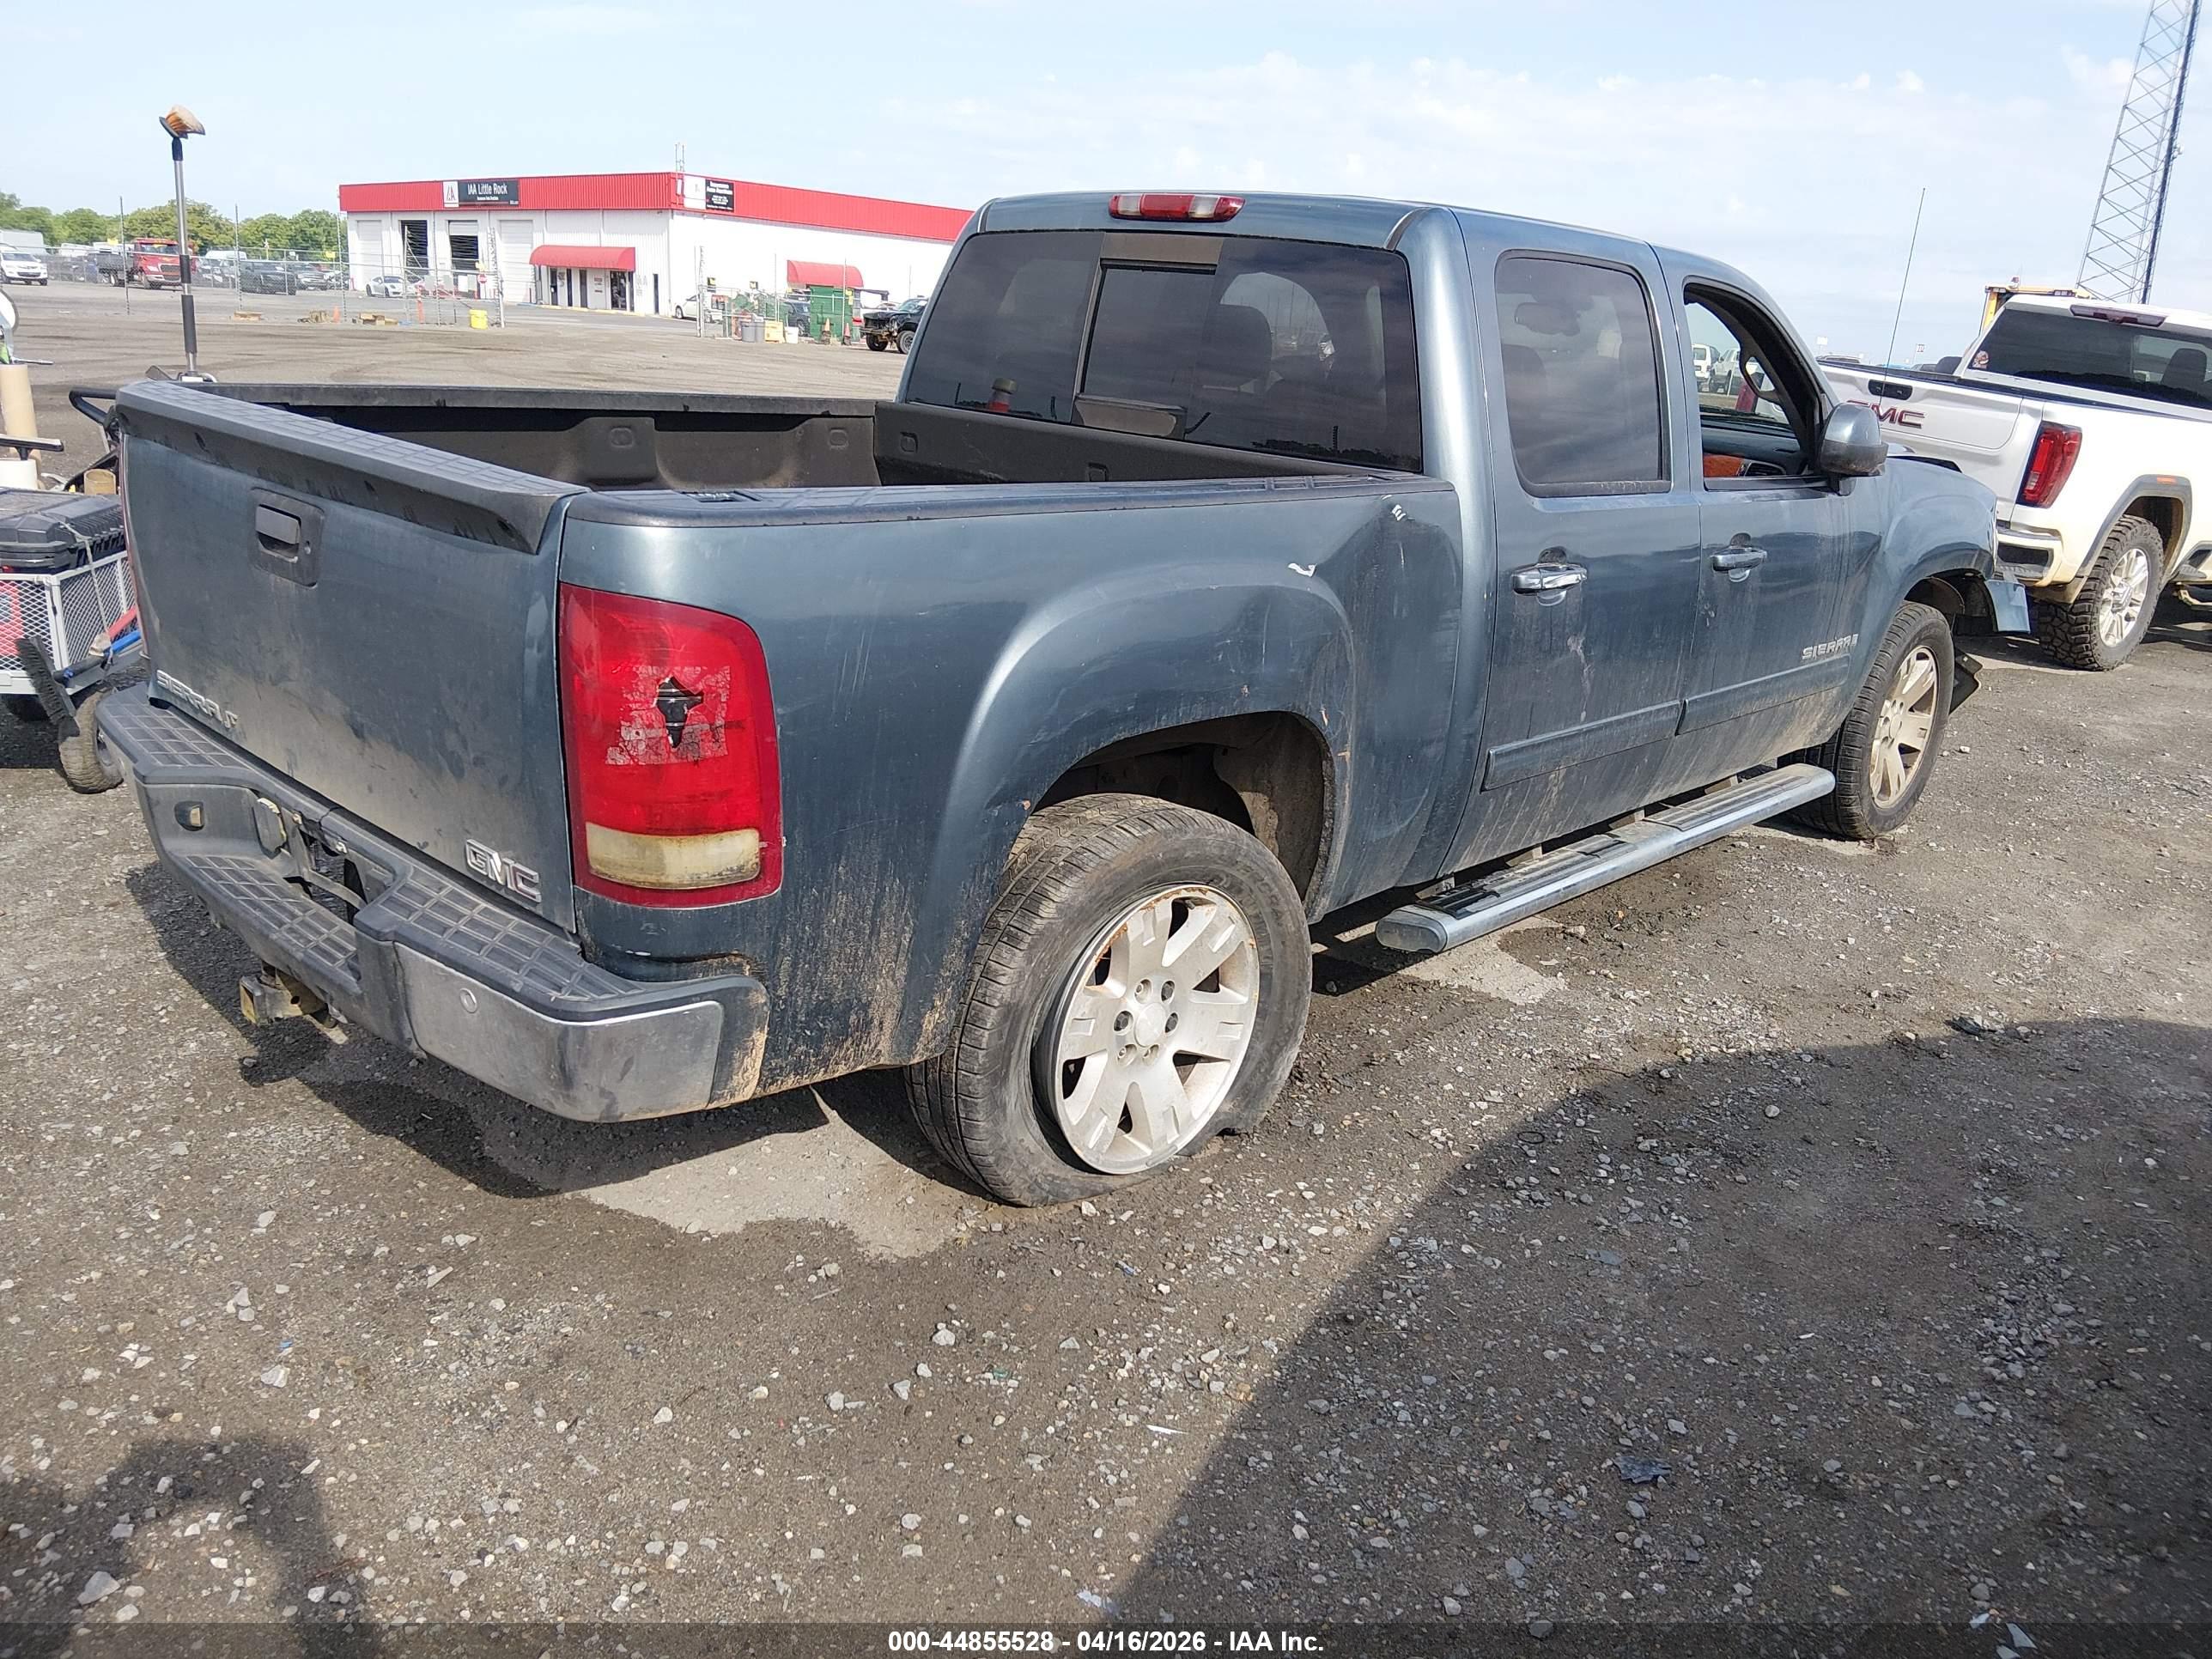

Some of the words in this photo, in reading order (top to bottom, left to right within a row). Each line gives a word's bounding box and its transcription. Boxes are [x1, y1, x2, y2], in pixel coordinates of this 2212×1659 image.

[477, 183, 492, 195] Little
[493, 182, 507, 195] Rock
[1846, 399, 1925, 429] MC
[156, 669, 223, 724] SIERRA
[465, 838, 542, 902] GMC
